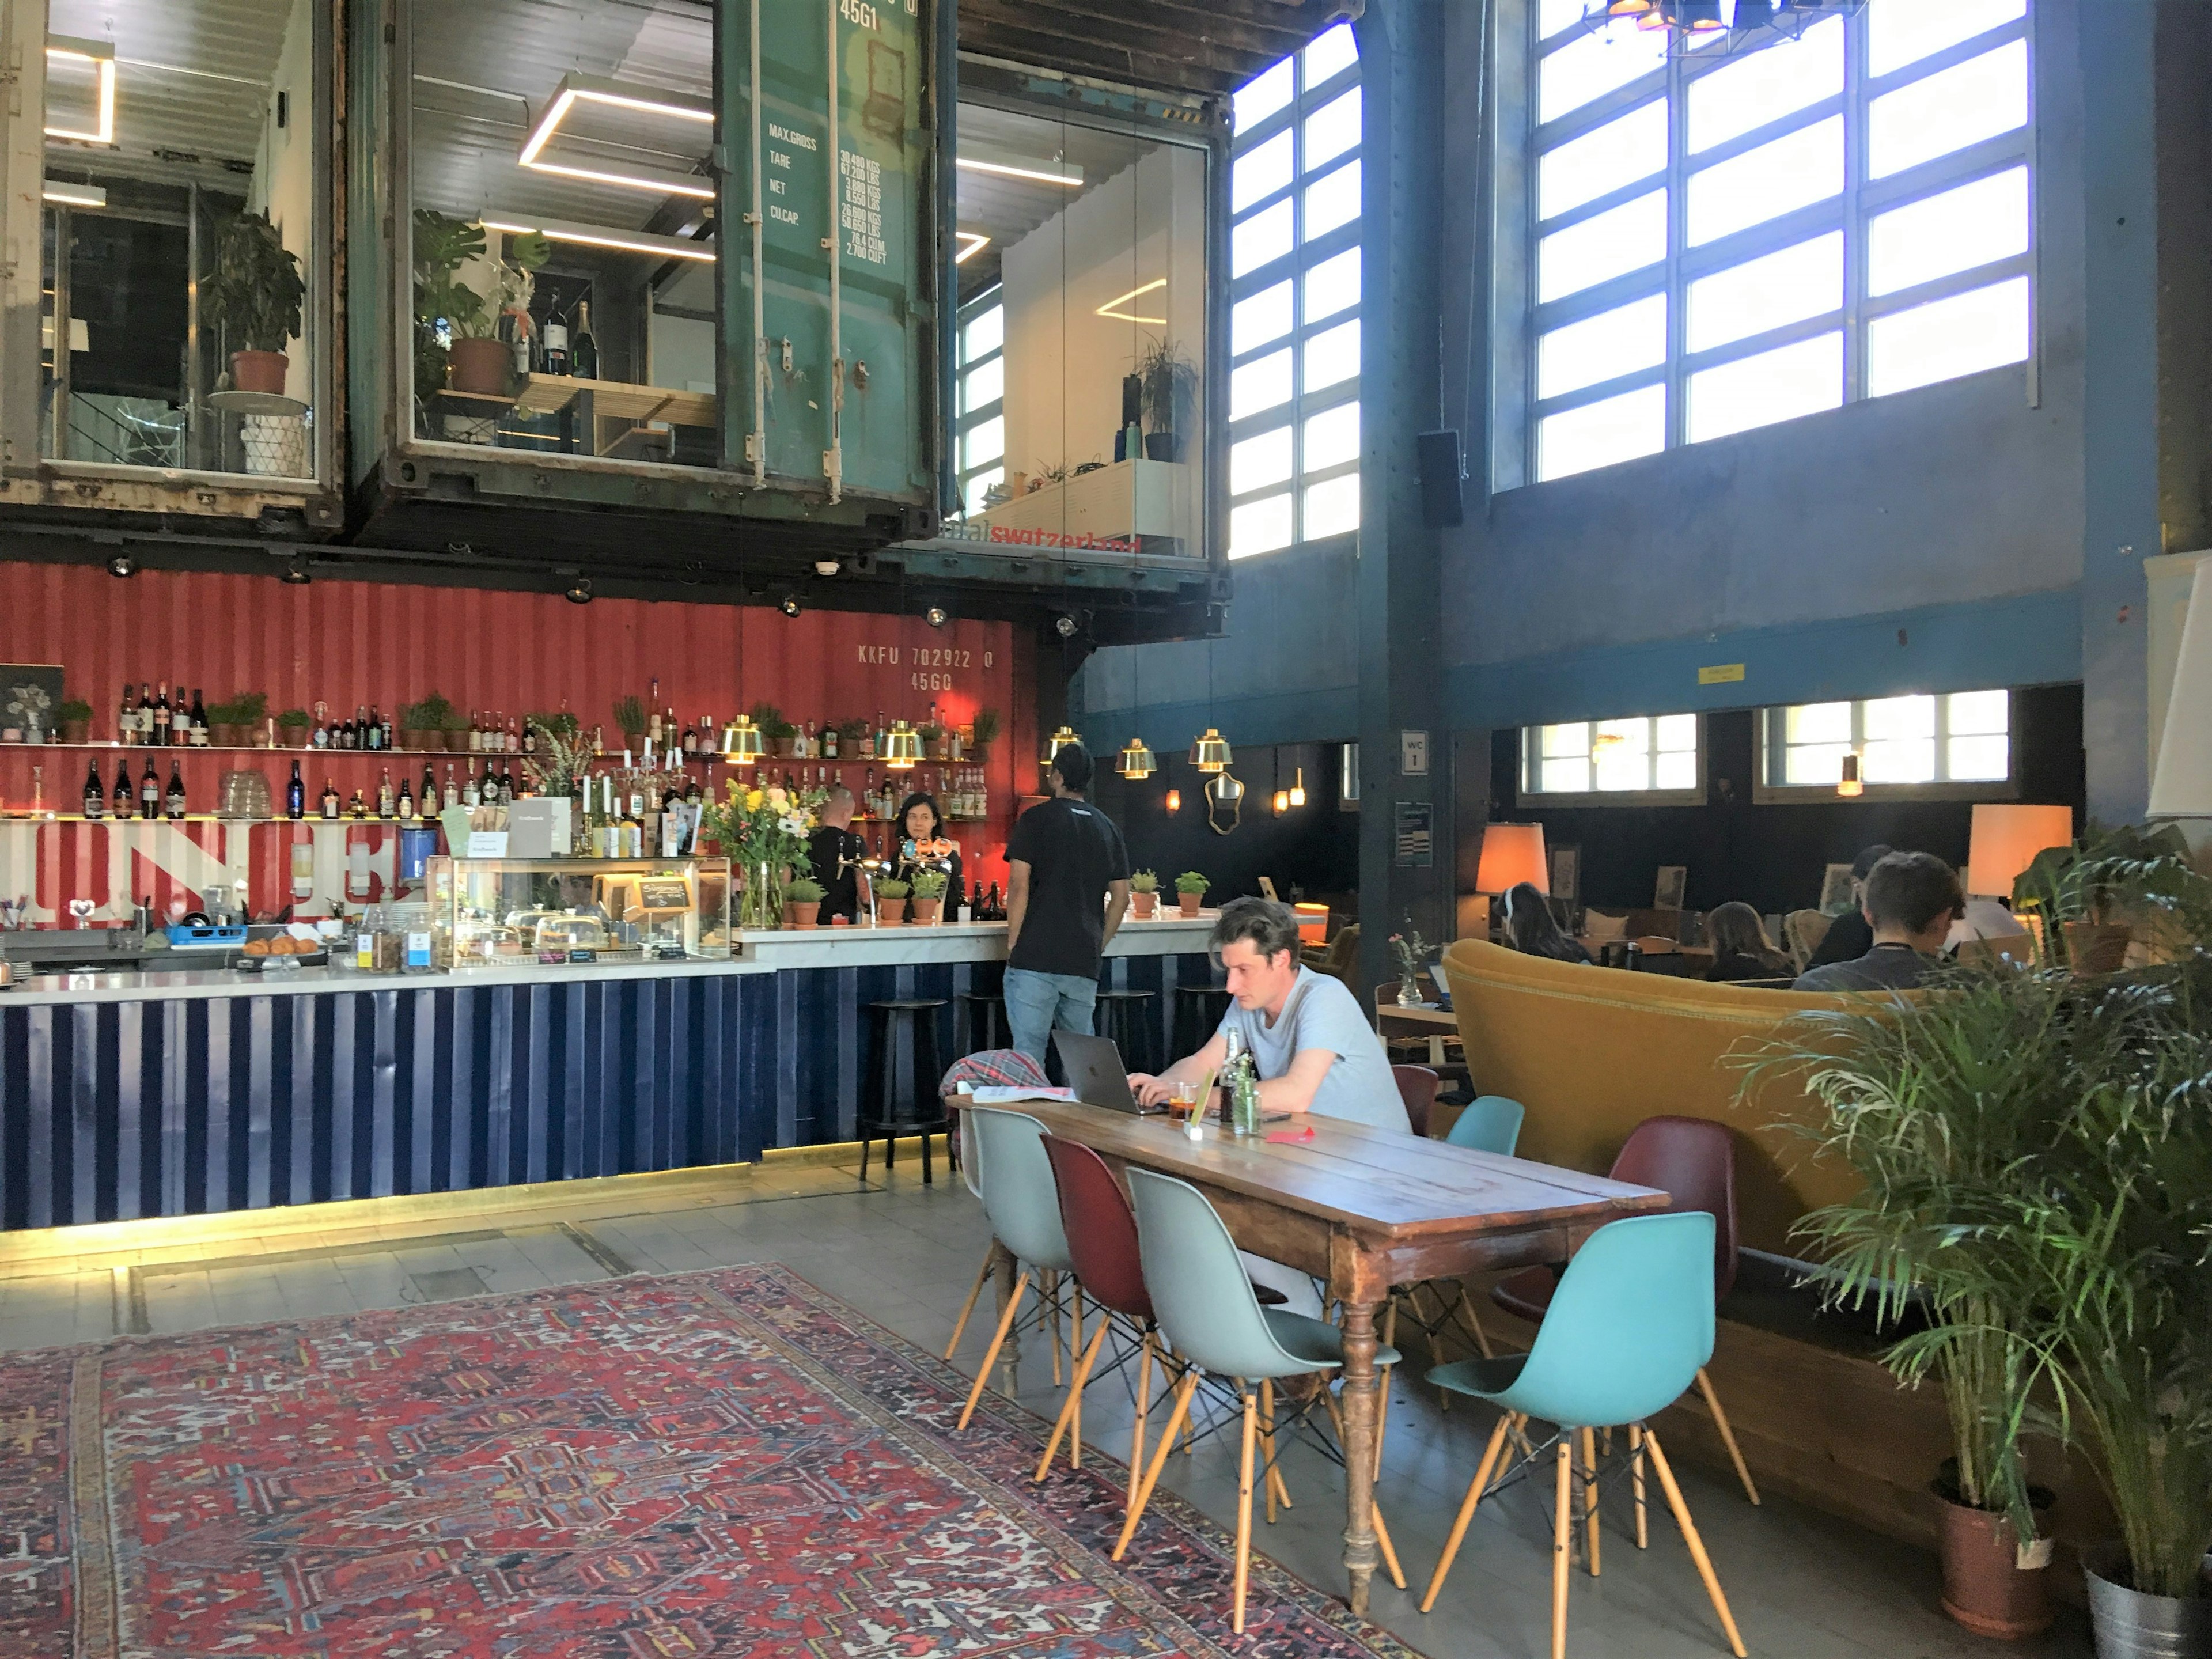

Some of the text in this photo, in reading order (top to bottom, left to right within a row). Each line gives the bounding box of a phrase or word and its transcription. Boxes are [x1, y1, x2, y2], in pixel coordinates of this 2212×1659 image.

[840, 0, 876, 30] 45G1
[769, 123, 817, 151] MAX.GROSS
[770, 150, 791, 169] TARE
[866, 158, 880, 174] KGS
[841, 162, 880, 186] 67.200 LBS
[770, 177, 786, 195] NET
[867, 184, 881, 199] KGS
[846, 189, 880, 211] 8.550 LBS
[770, 204, 799, 226] CU.CAP.
[868, 211, 881, 226] KGS
[851, 231, 866, 247] 76.4
[868, 223, 881, 238] LBS
[847, 242, 866, 259] 2.700
[858, 645, 899, 665] KKFU
[912, 647, 970, 668] 702922
[1407, 741, 1422, 749] WC
